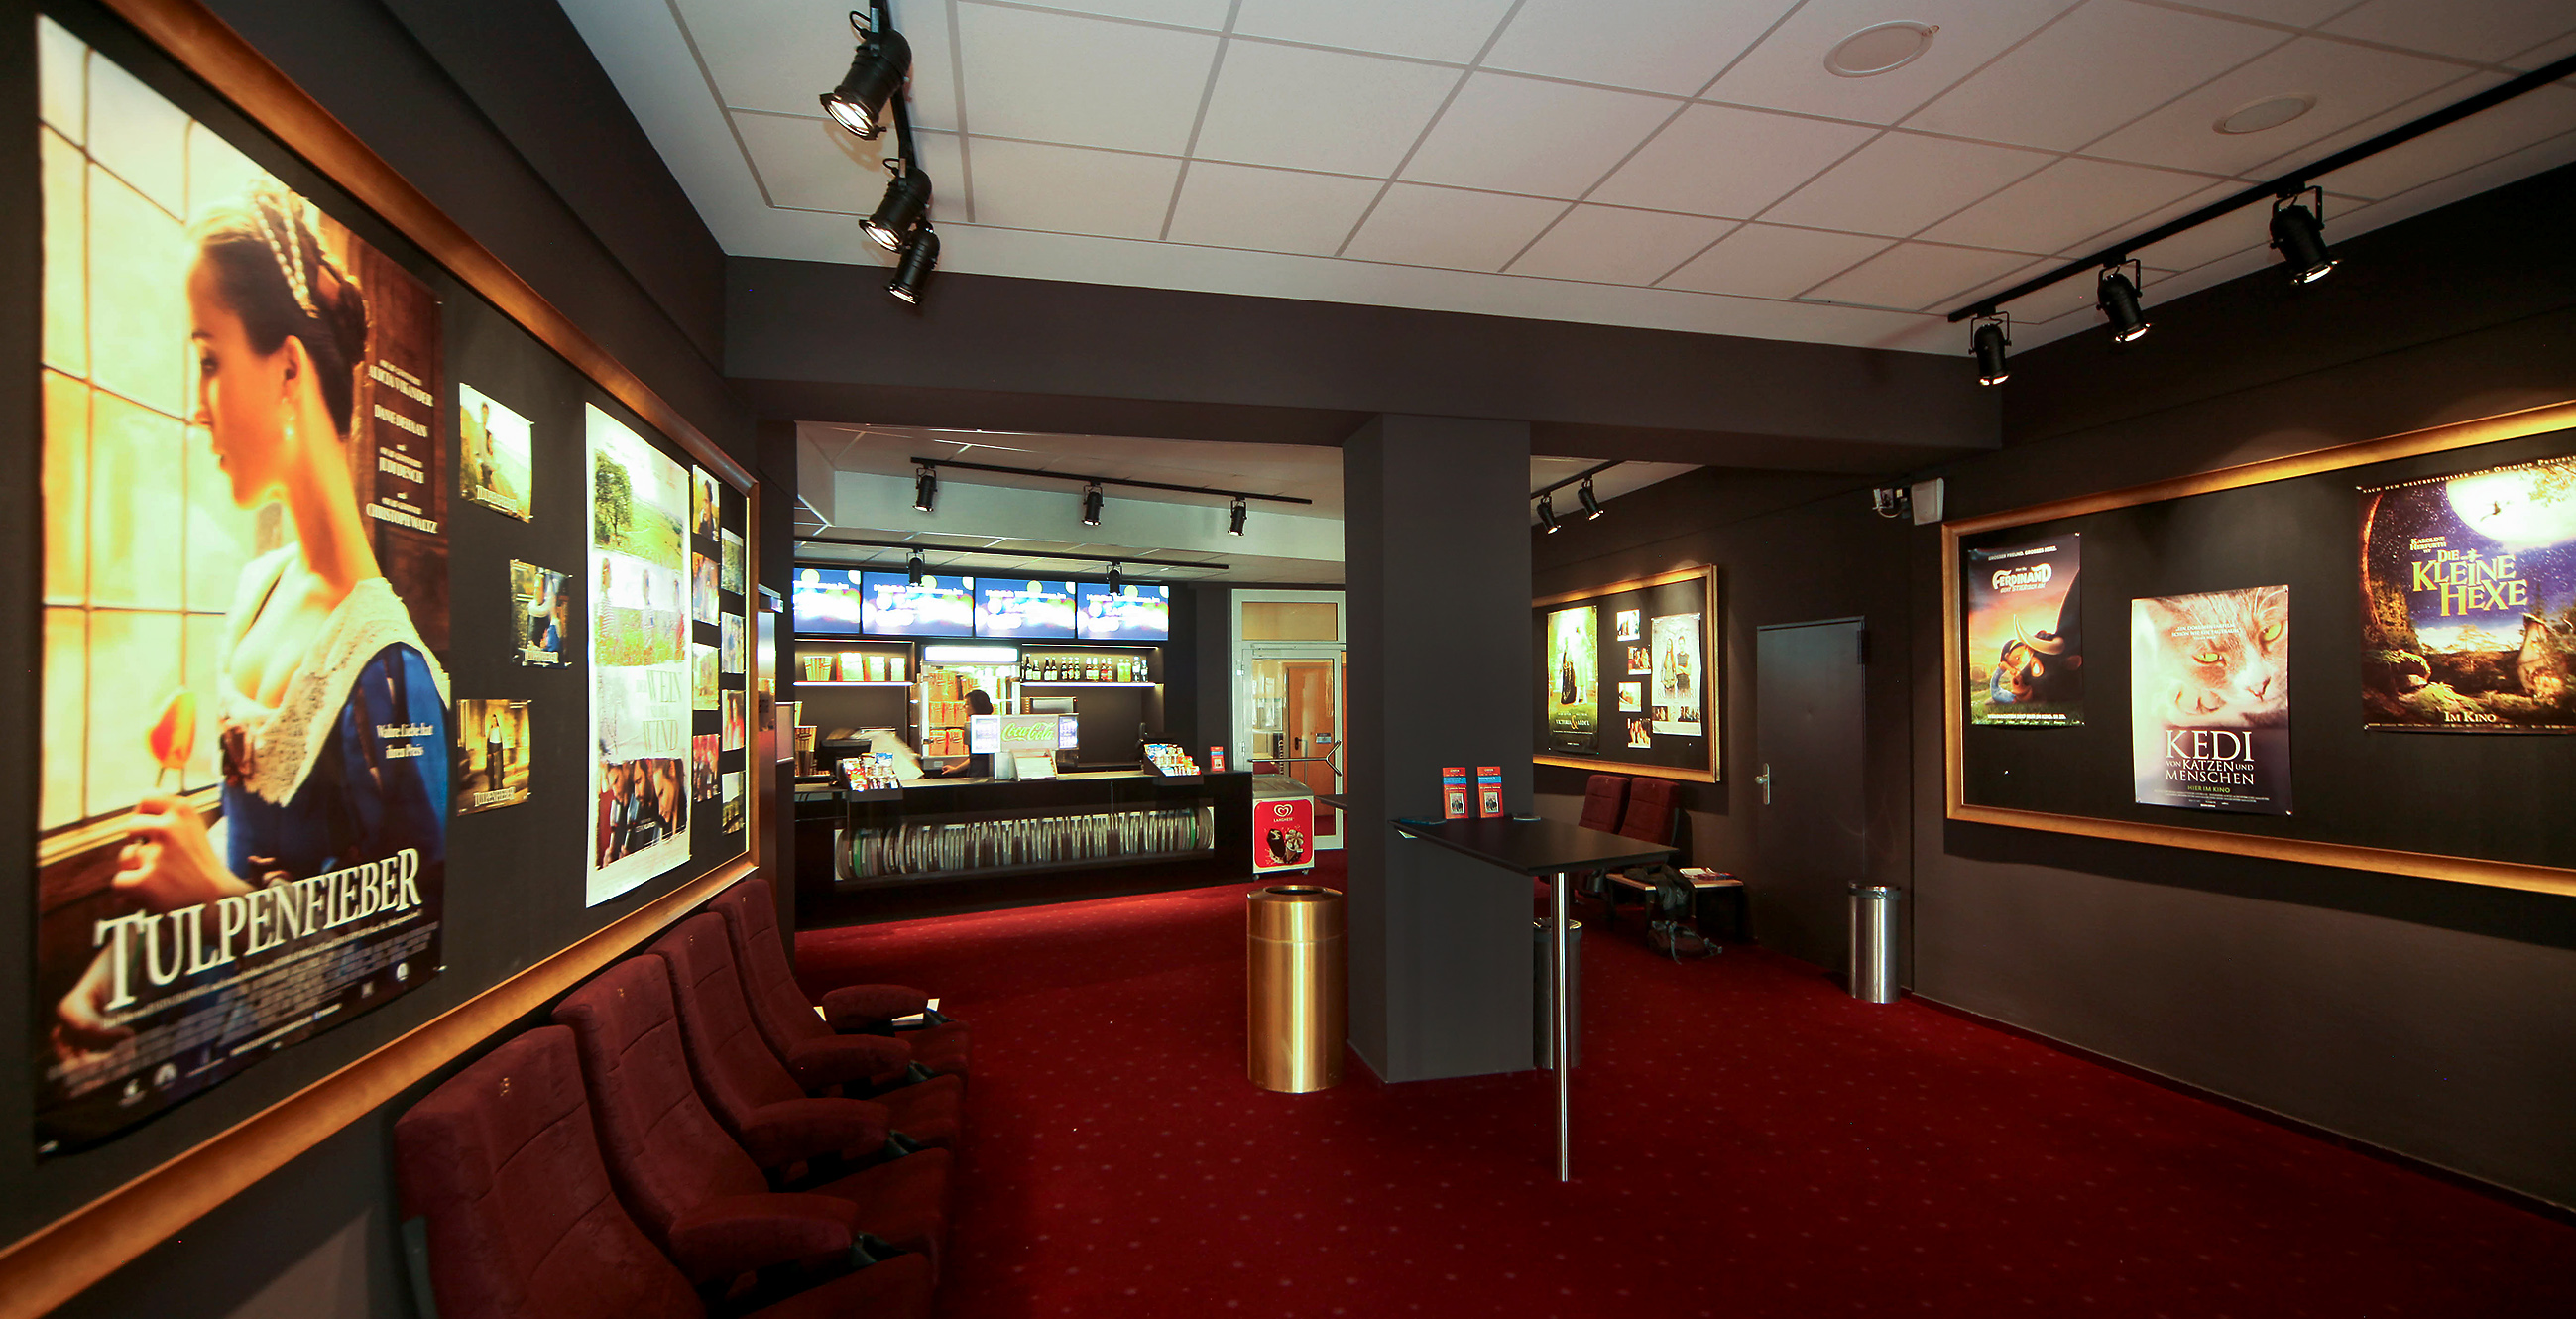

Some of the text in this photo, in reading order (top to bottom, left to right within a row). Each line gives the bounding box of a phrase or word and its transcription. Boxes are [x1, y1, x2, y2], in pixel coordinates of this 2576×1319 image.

[2410, 536, 2446, 545] KAROLINE
[2437, 549, 2460, 563] DIE
[1992, 562, 2052, 590] FERDINAND
[2411, 553, 2517, 592] KLEINE
[2439, 579, 2528, 617] HEXE
[2444, 711, 2497, 723] IM KINO
[376, 723, 402, 738] Wahre
[401, 723, 420, 737] Liebe
[2166, 729, 2255, 762] KEDI
[2182, 759, 2234, 772] KATZEN
[2166, 769, 2254, 785] MENSCHEN
[92, 846, 423, 1012] TULPENFIEBER
